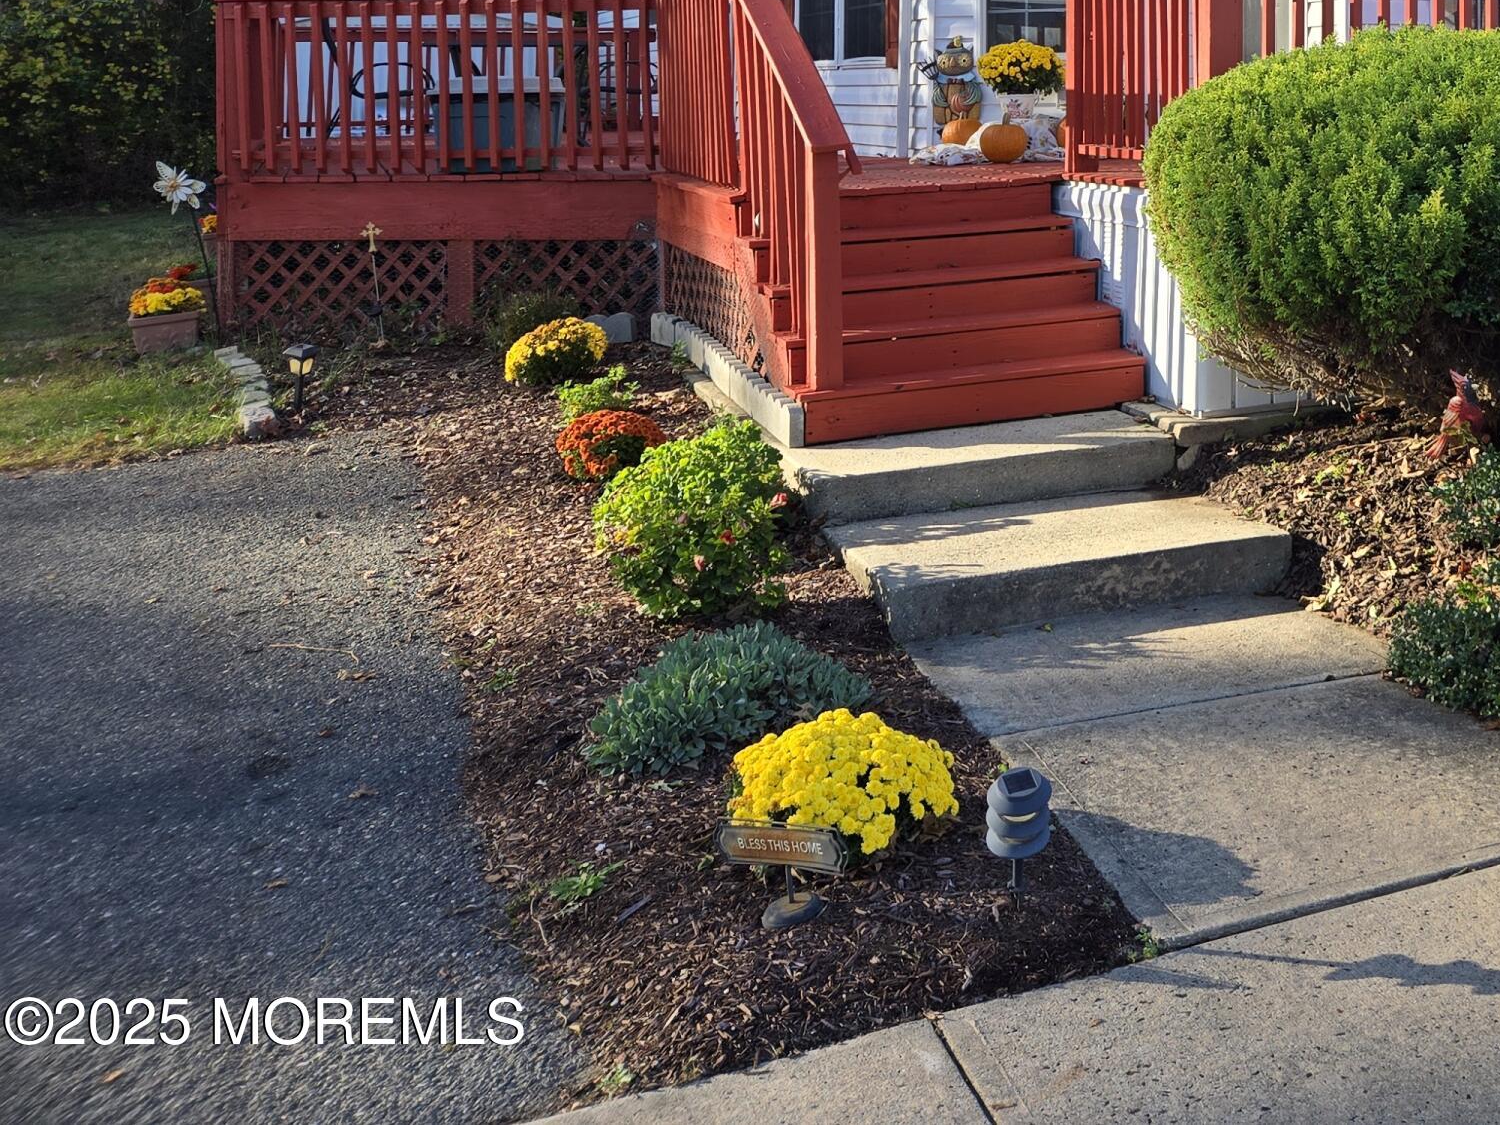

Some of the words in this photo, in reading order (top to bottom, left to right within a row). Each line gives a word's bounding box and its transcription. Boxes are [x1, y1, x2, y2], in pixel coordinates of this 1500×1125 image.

[737, 837, 767, 851] BLESS
[767, 839, 790, 852] THIS
[791, 840, 824, 855] HOME
